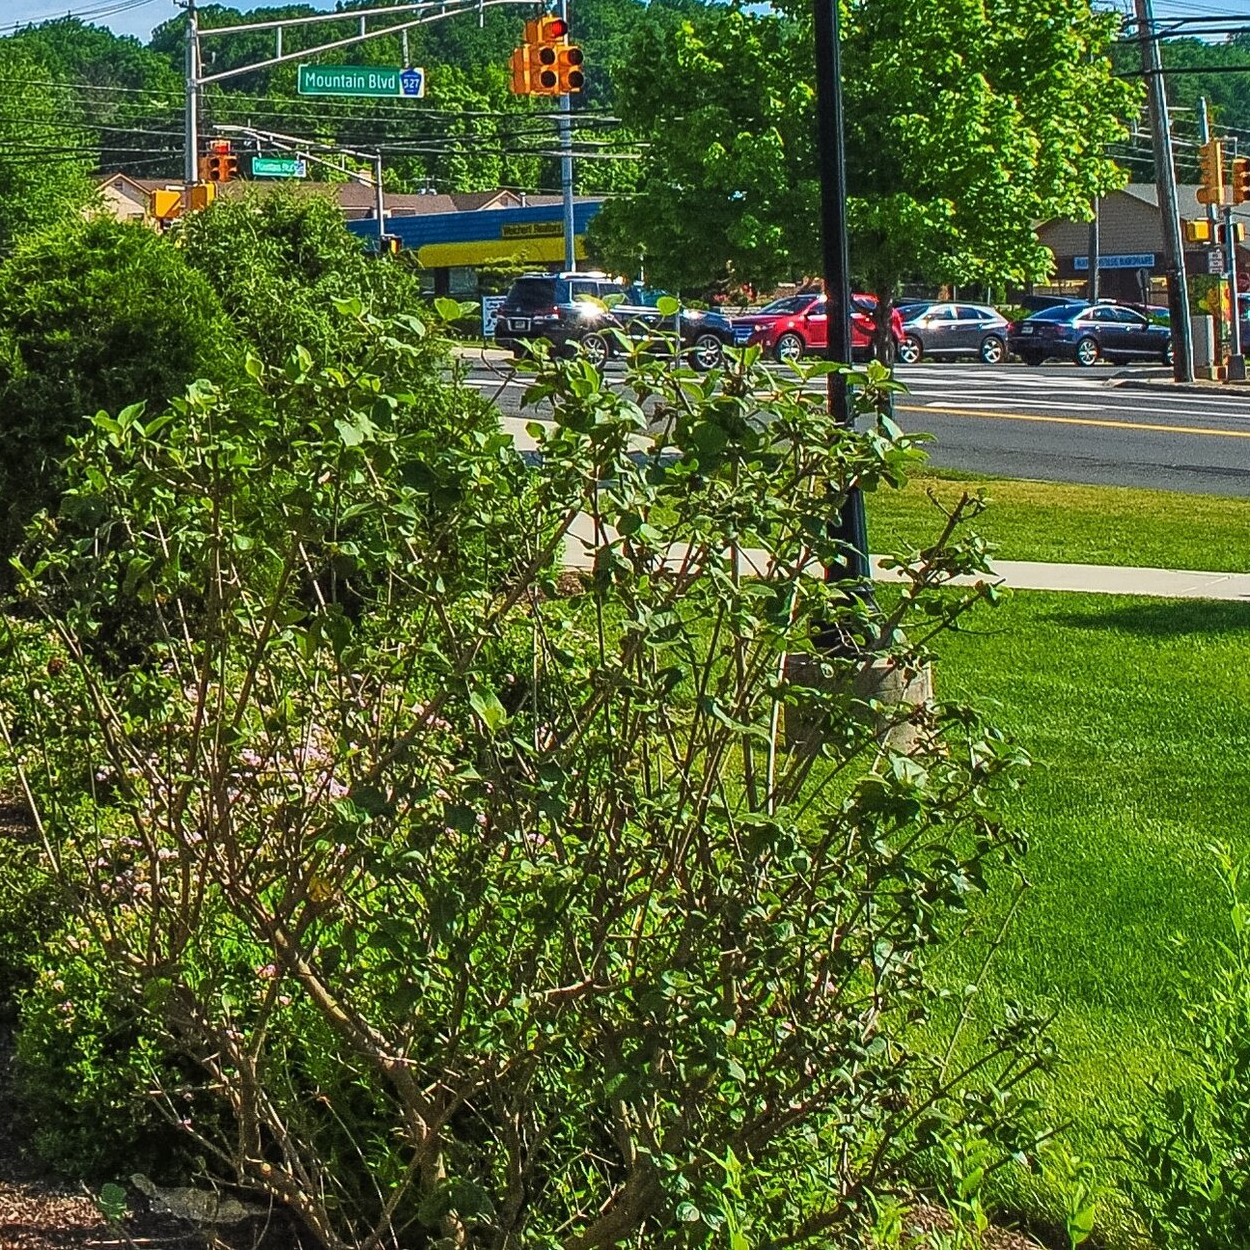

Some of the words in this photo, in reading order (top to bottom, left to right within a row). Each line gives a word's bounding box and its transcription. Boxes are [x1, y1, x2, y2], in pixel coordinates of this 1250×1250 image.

[305, 72, 365, 89] Mountain
[368, 73, 395, 89] Blvd
[403, 78, 420, 89] 527
[503, 224, 531, 236] Weichert
